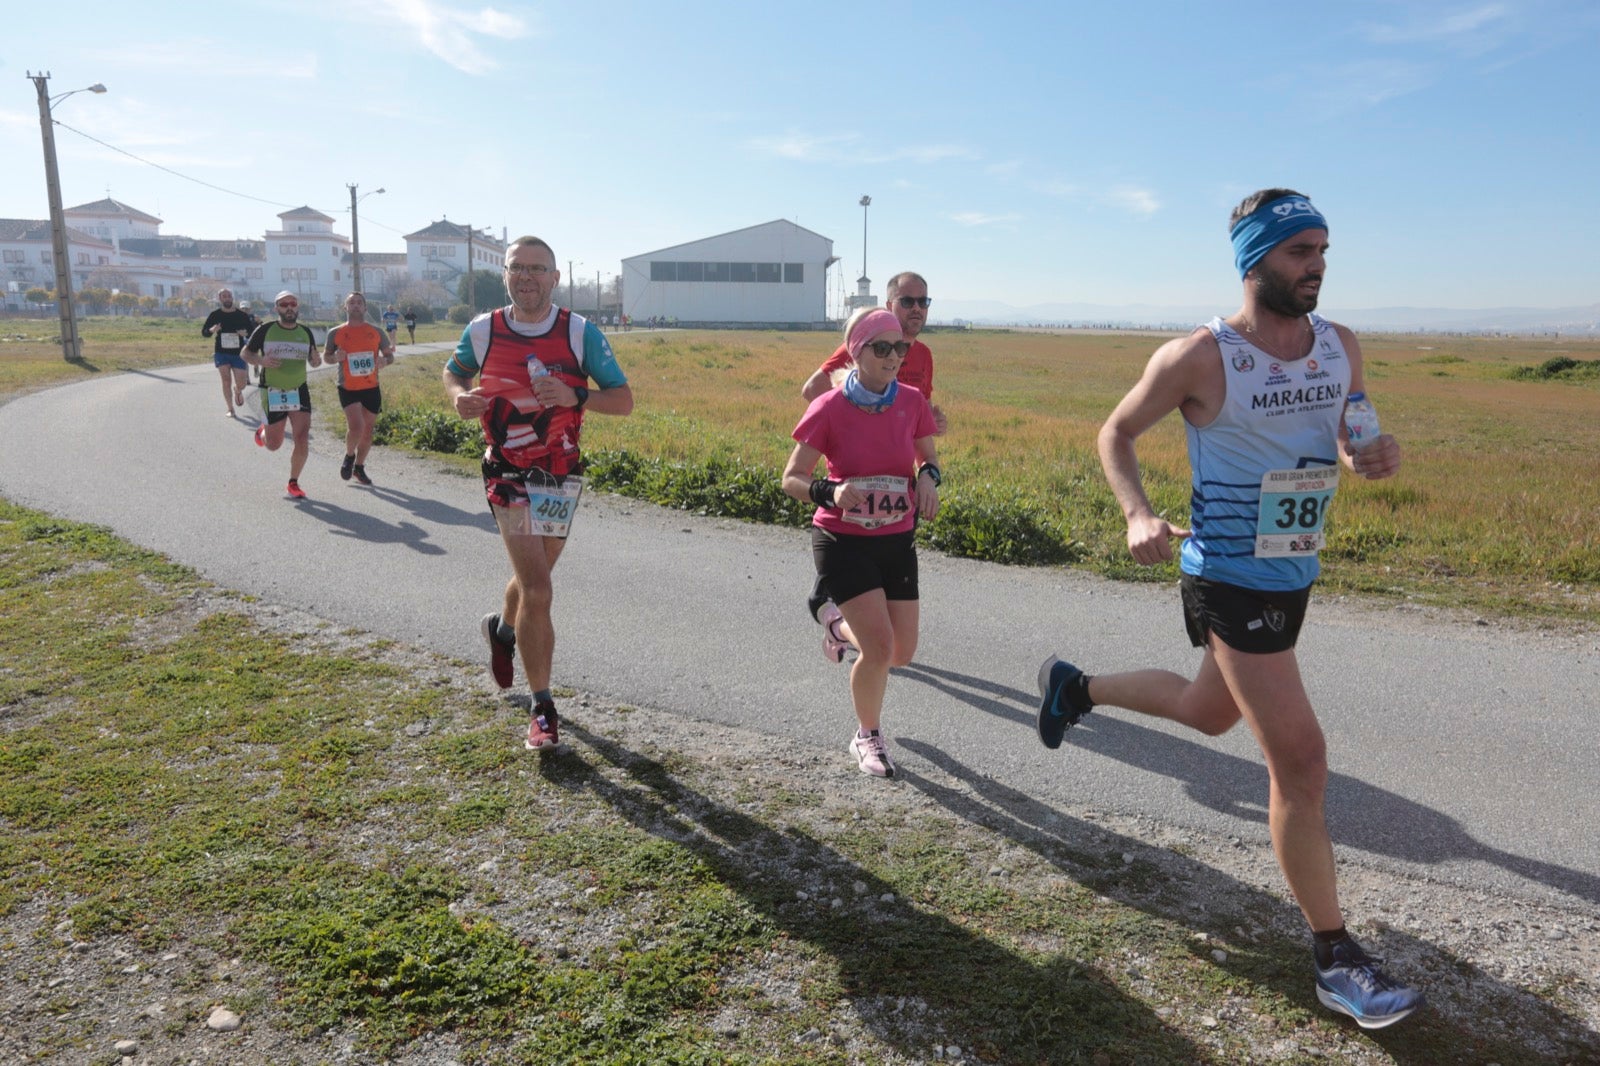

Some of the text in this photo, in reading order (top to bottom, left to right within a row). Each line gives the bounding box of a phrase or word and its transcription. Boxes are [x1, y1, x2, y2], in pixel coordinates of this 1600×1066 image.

[353, 358, 371, 369] 966
[281, 395, 287, 403] 5
[1251, 383, 1342, 409] MARACENA
[1266, 408, 1285, 417] CLUB
[537, 498, 570, 519] 408
